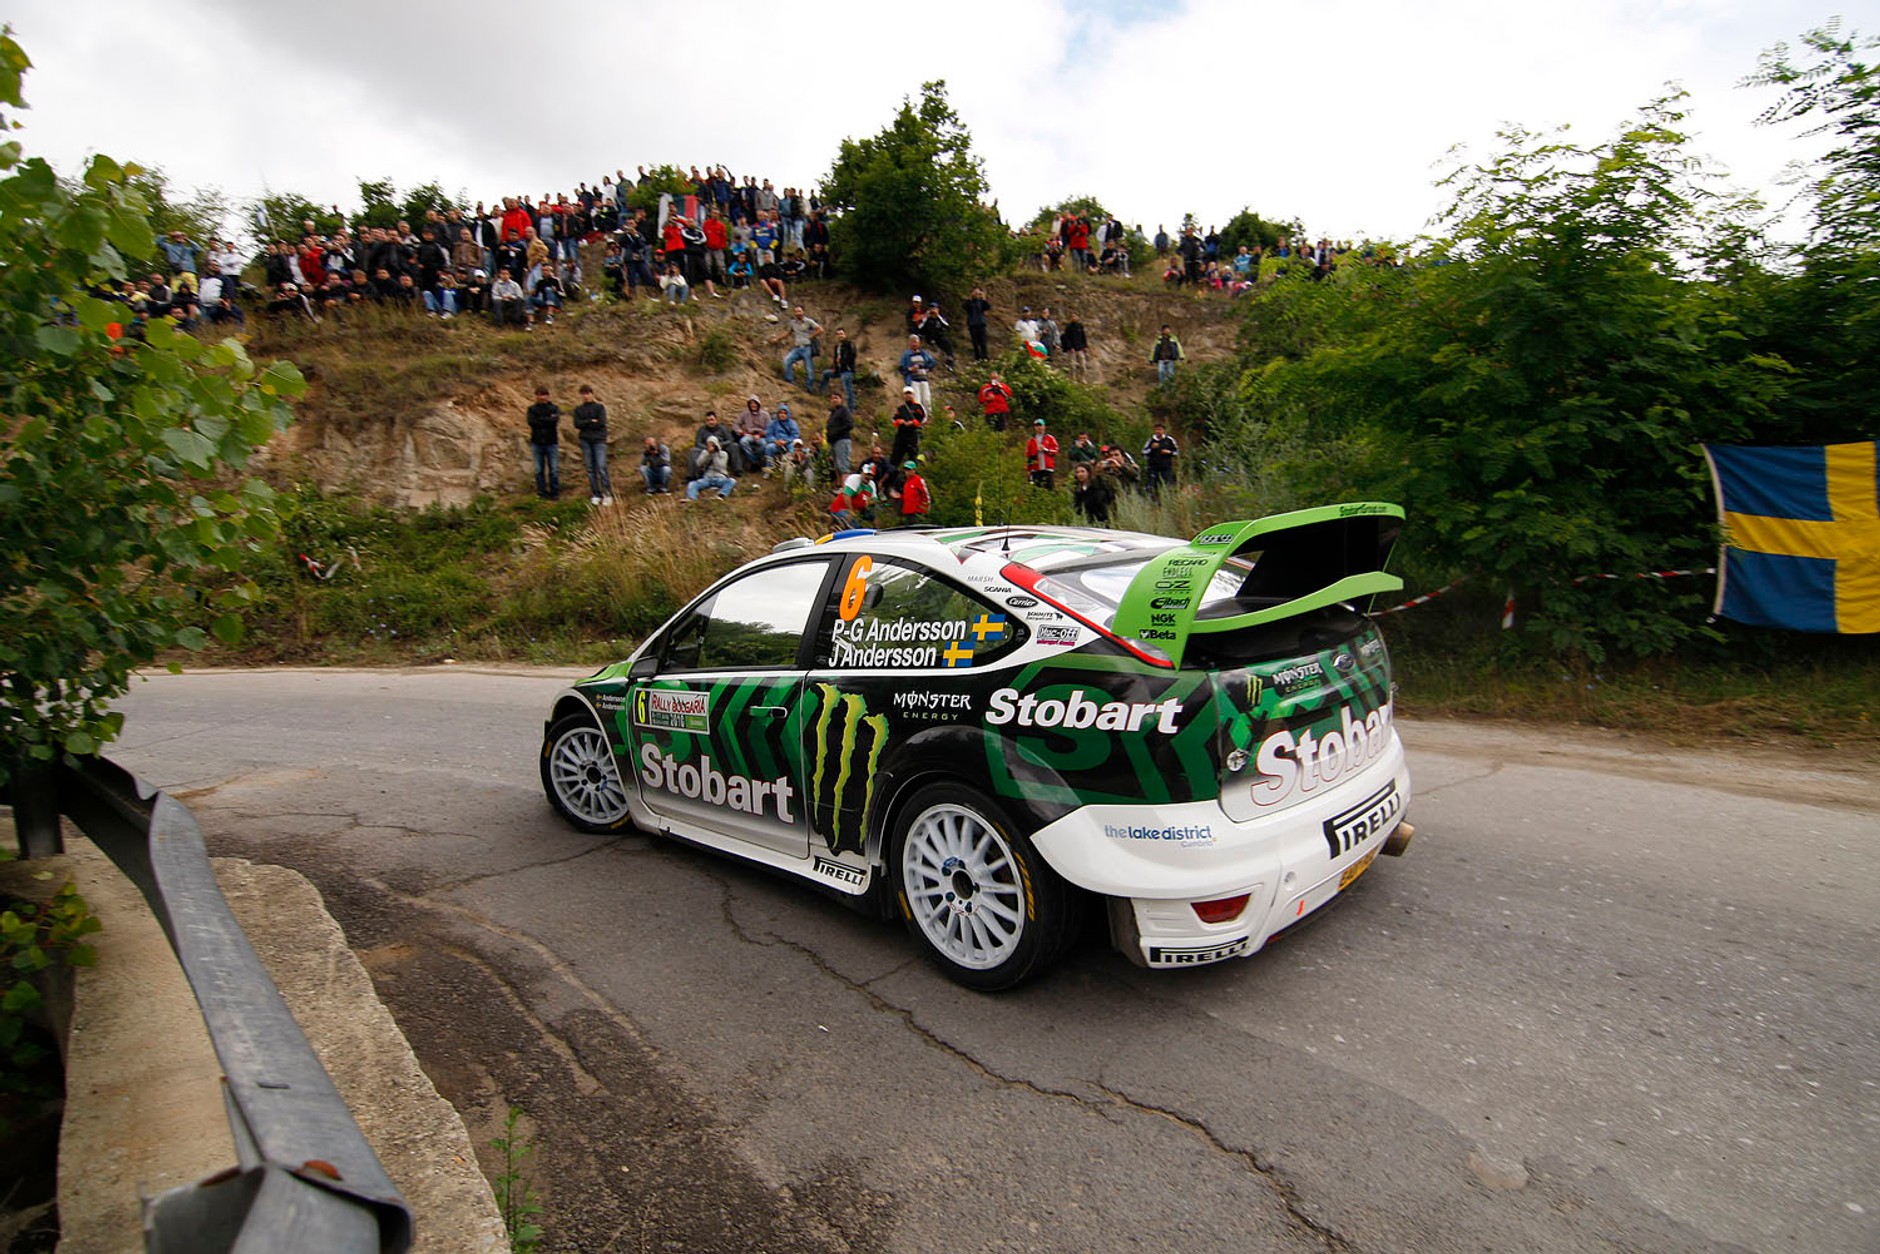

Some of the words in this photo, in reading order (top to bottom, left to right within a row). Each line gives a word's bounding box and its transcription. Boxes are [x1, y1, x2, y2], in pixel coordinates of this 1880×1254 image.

[839, 554, 873, 621] 6
[967, 575, 994, 583] MARSH
[1007, 598, 1036, 607] Carrier
[832, 618, 864, 642] P-G
[865, 617, 966, 642] Andersson
[1151, 613, 1176, 622] NGK
[1151, 629, 1176, 640] Beta
[828, 643, 839, 667] J
[841, 643, 937, 667] Andersson
[1272, 662, 1323, 685] MONSTER
[637, 691, 646, 723] 6
[893, 690, 972, 710] MONSTER
[984, 687, 1183, 734] Stobart
[903, 711, 958, 720] ENERGY
[1250, 704, 1392, 807] Stobar
[641, 742, 794, 824] Stobart
[1322, 777, 1401, 860] PIRELLI
[813, 855, 867, 886] PIRELLI
[1150, 936, 1249, 963] PIRELLI
